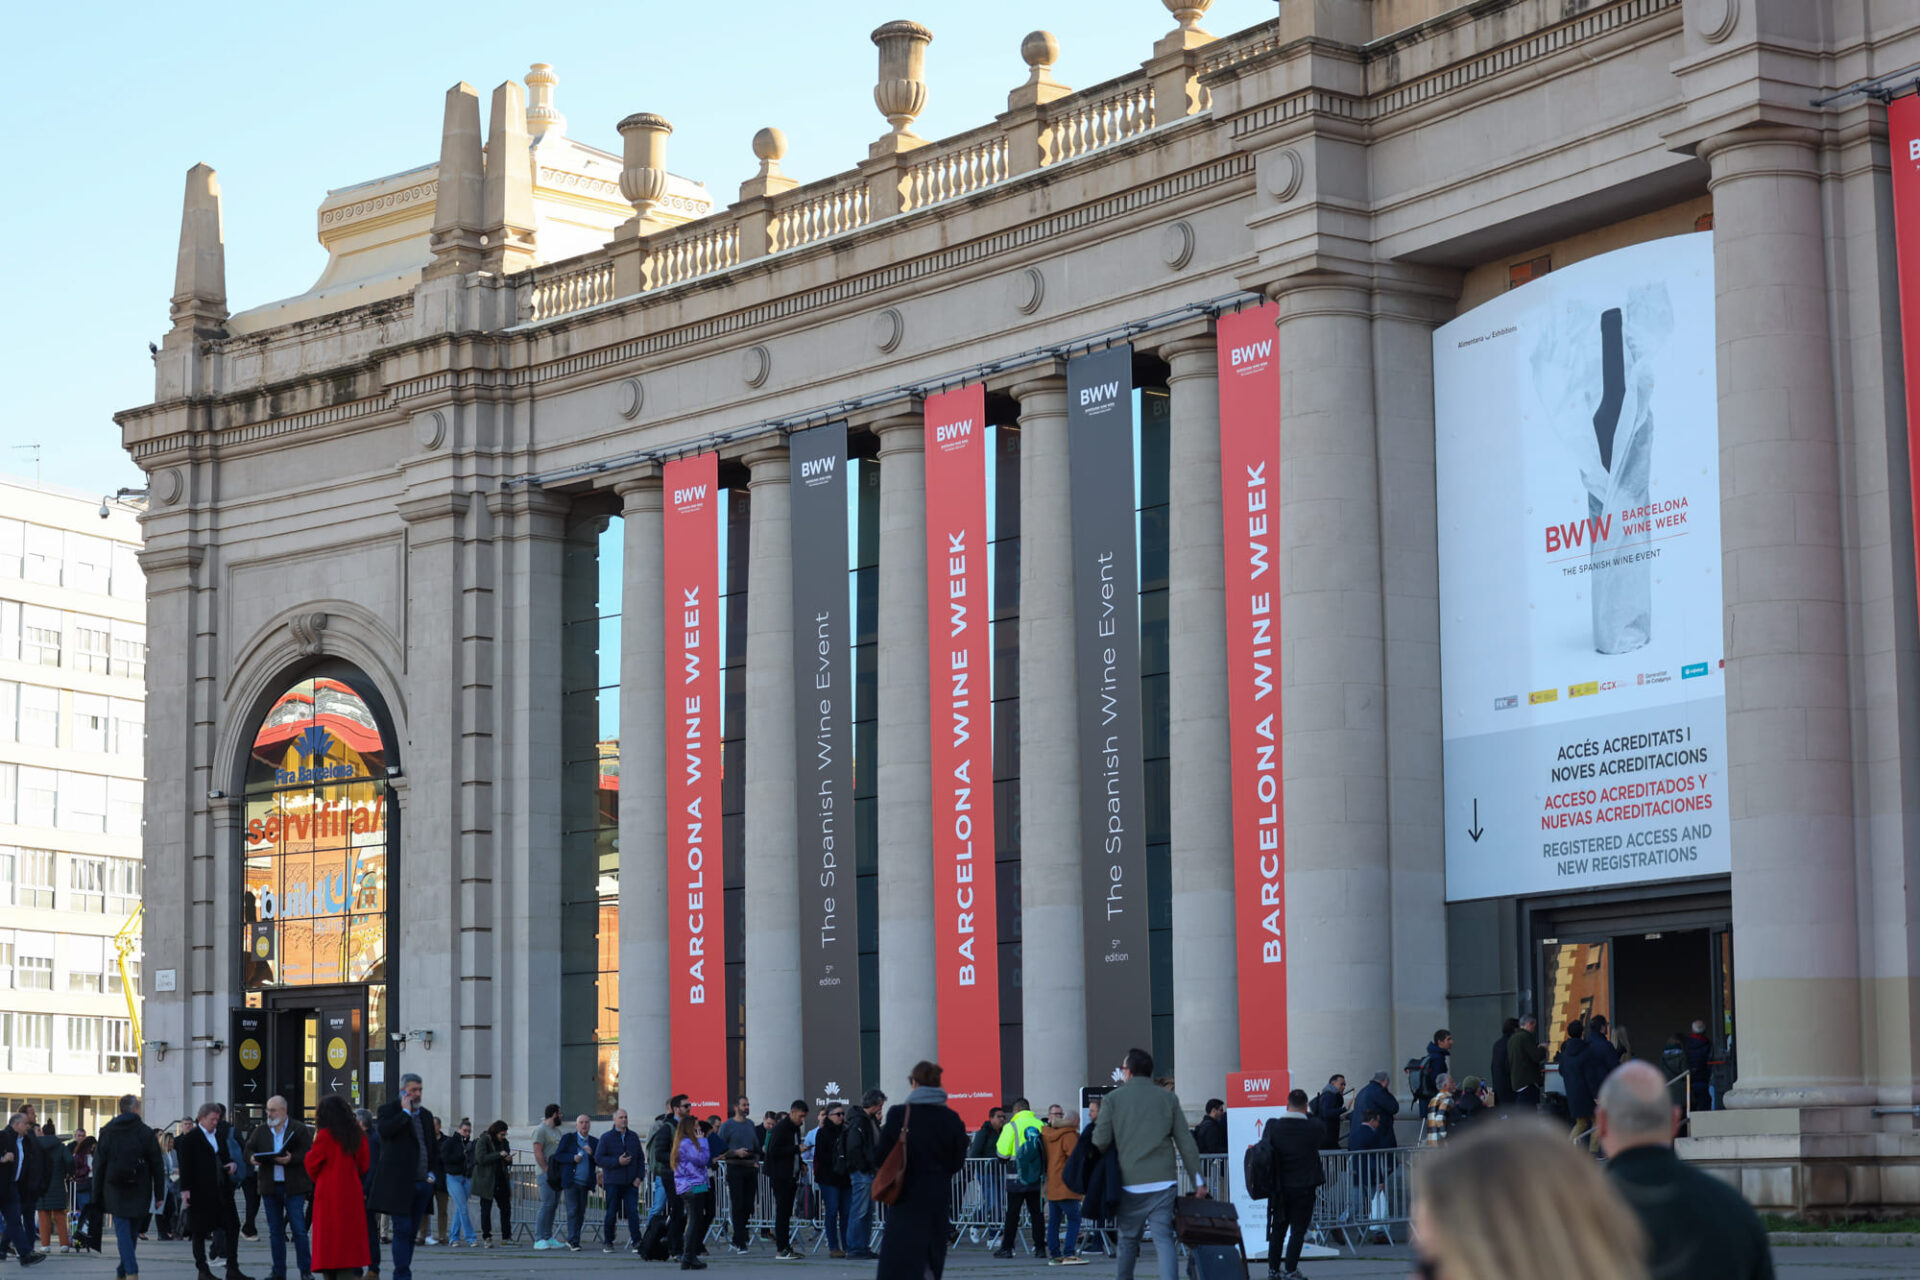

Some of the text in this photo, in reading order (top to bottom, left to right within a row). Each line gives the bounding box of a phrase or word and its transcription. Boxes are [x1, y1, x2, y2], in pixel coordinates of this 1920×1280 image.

[1231, 339, 1272, 366] BWW
[1081, 380, 1119, 406] BWW
[937, 418, 972, 442] BWW
[802, 455, 836, 478] BWW
[674, 484, 707, 505] BWW
[1622, 497, 1688, 521] BARCELONA
[1546, 513, 1612, 553] BWW
[1623, 512, 1687, 536] WINE WEEK
[1562, 548, 1661, 576] THE SPANISH WINE EVENT
[1247, 460, 1282, 964] BARCELONA WINE WEEK
[1097, 551, 1124, 921] The Spanish Wine Event
[1558, 727, 1691, 761] ACCÉS ACREDITATS I
[949, 529, 976, 986] BARCELONA WINE WEEK
[1551, 748, 1708, 783] NOVES ACREDITACIONS
[275, 762, 353, 784] Fira Barcelona
[815, 611, 837, 949] The Spanish Wine Event
[684, 585, 705, 1004] BARCELONA WINE WEEK
[1544, 774, 1708, 810] ACCESO ACREDITADOS Y
[1541, 794, 1712, 830] NUEVAS ACREDITACIONES
[1543, 824, 1712, 858] REGISTERED ACCESS AND
[1557, 846, 1698, 876] NEW REGISTRATIONS
[1104, 952, 1129, 963] edition
[819, 976, 841, 986] edition
[330, 1018, 345, 1026] BWW
[242, 1049, 258, 1059] CIS
[330, 1047, 345, 1058] CIS
[1244, 1078, 1271, 1092] BWW
